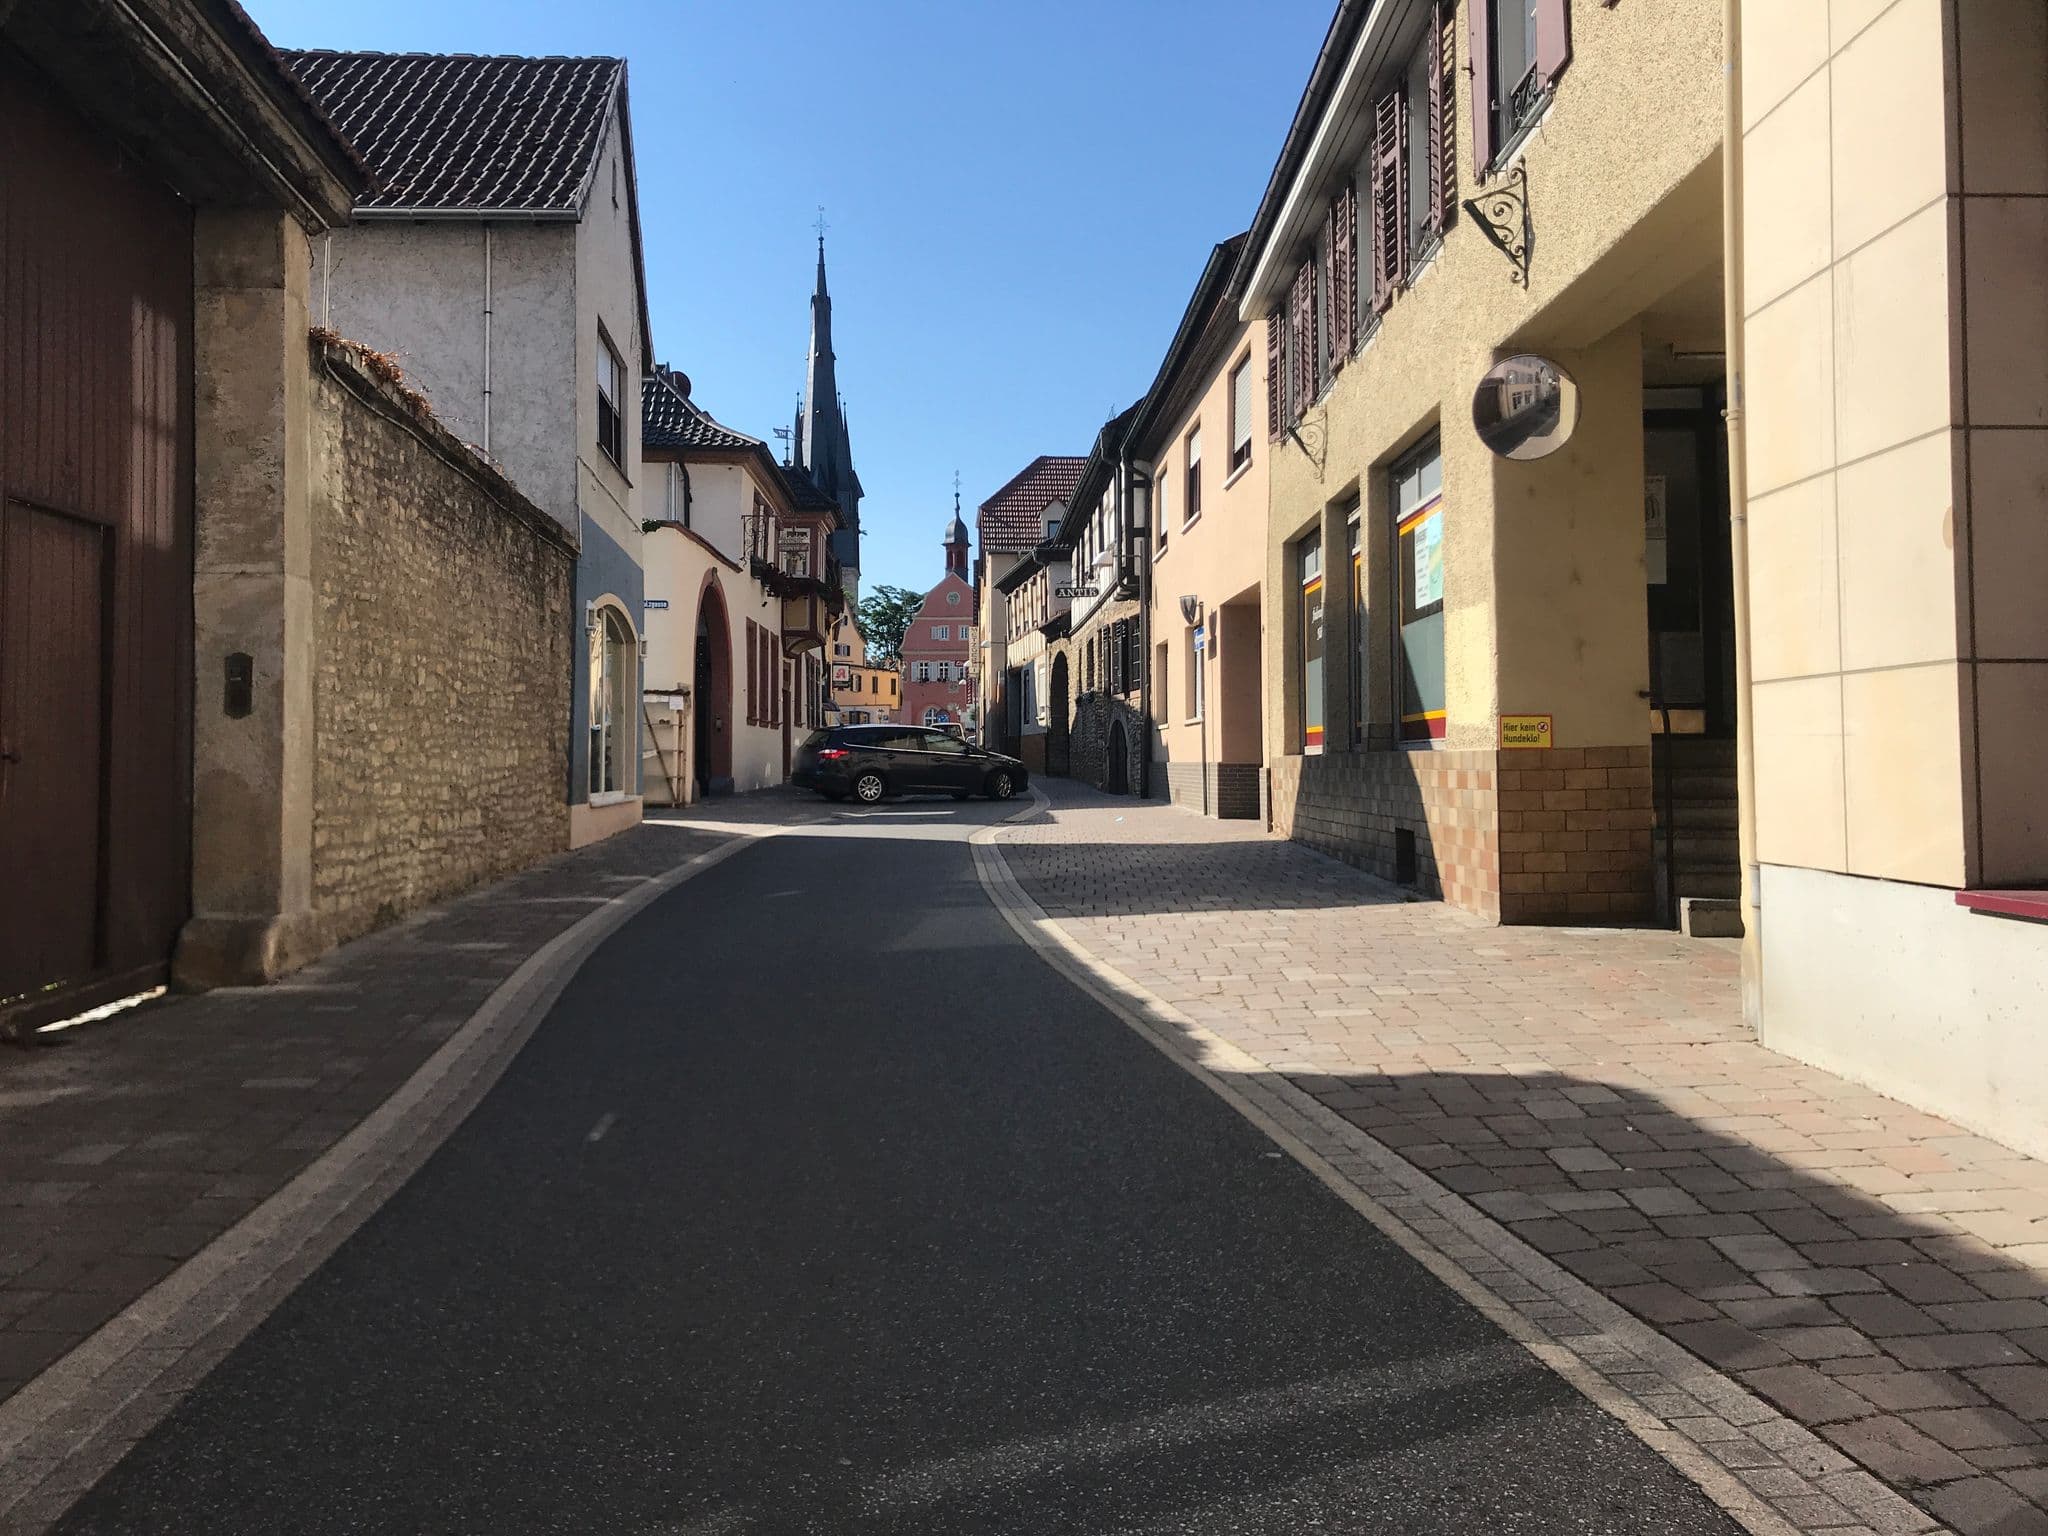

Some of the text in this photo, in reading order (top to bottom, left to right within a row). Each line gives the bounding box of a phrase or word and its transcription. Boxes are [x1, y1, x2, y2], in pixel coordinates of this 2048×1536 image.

[1058, 589, 1097, 597] ANTIK
[1503, 722, 1536, 731] Hier kein
[1503, 734, 1540, 743] Hundeklo!
